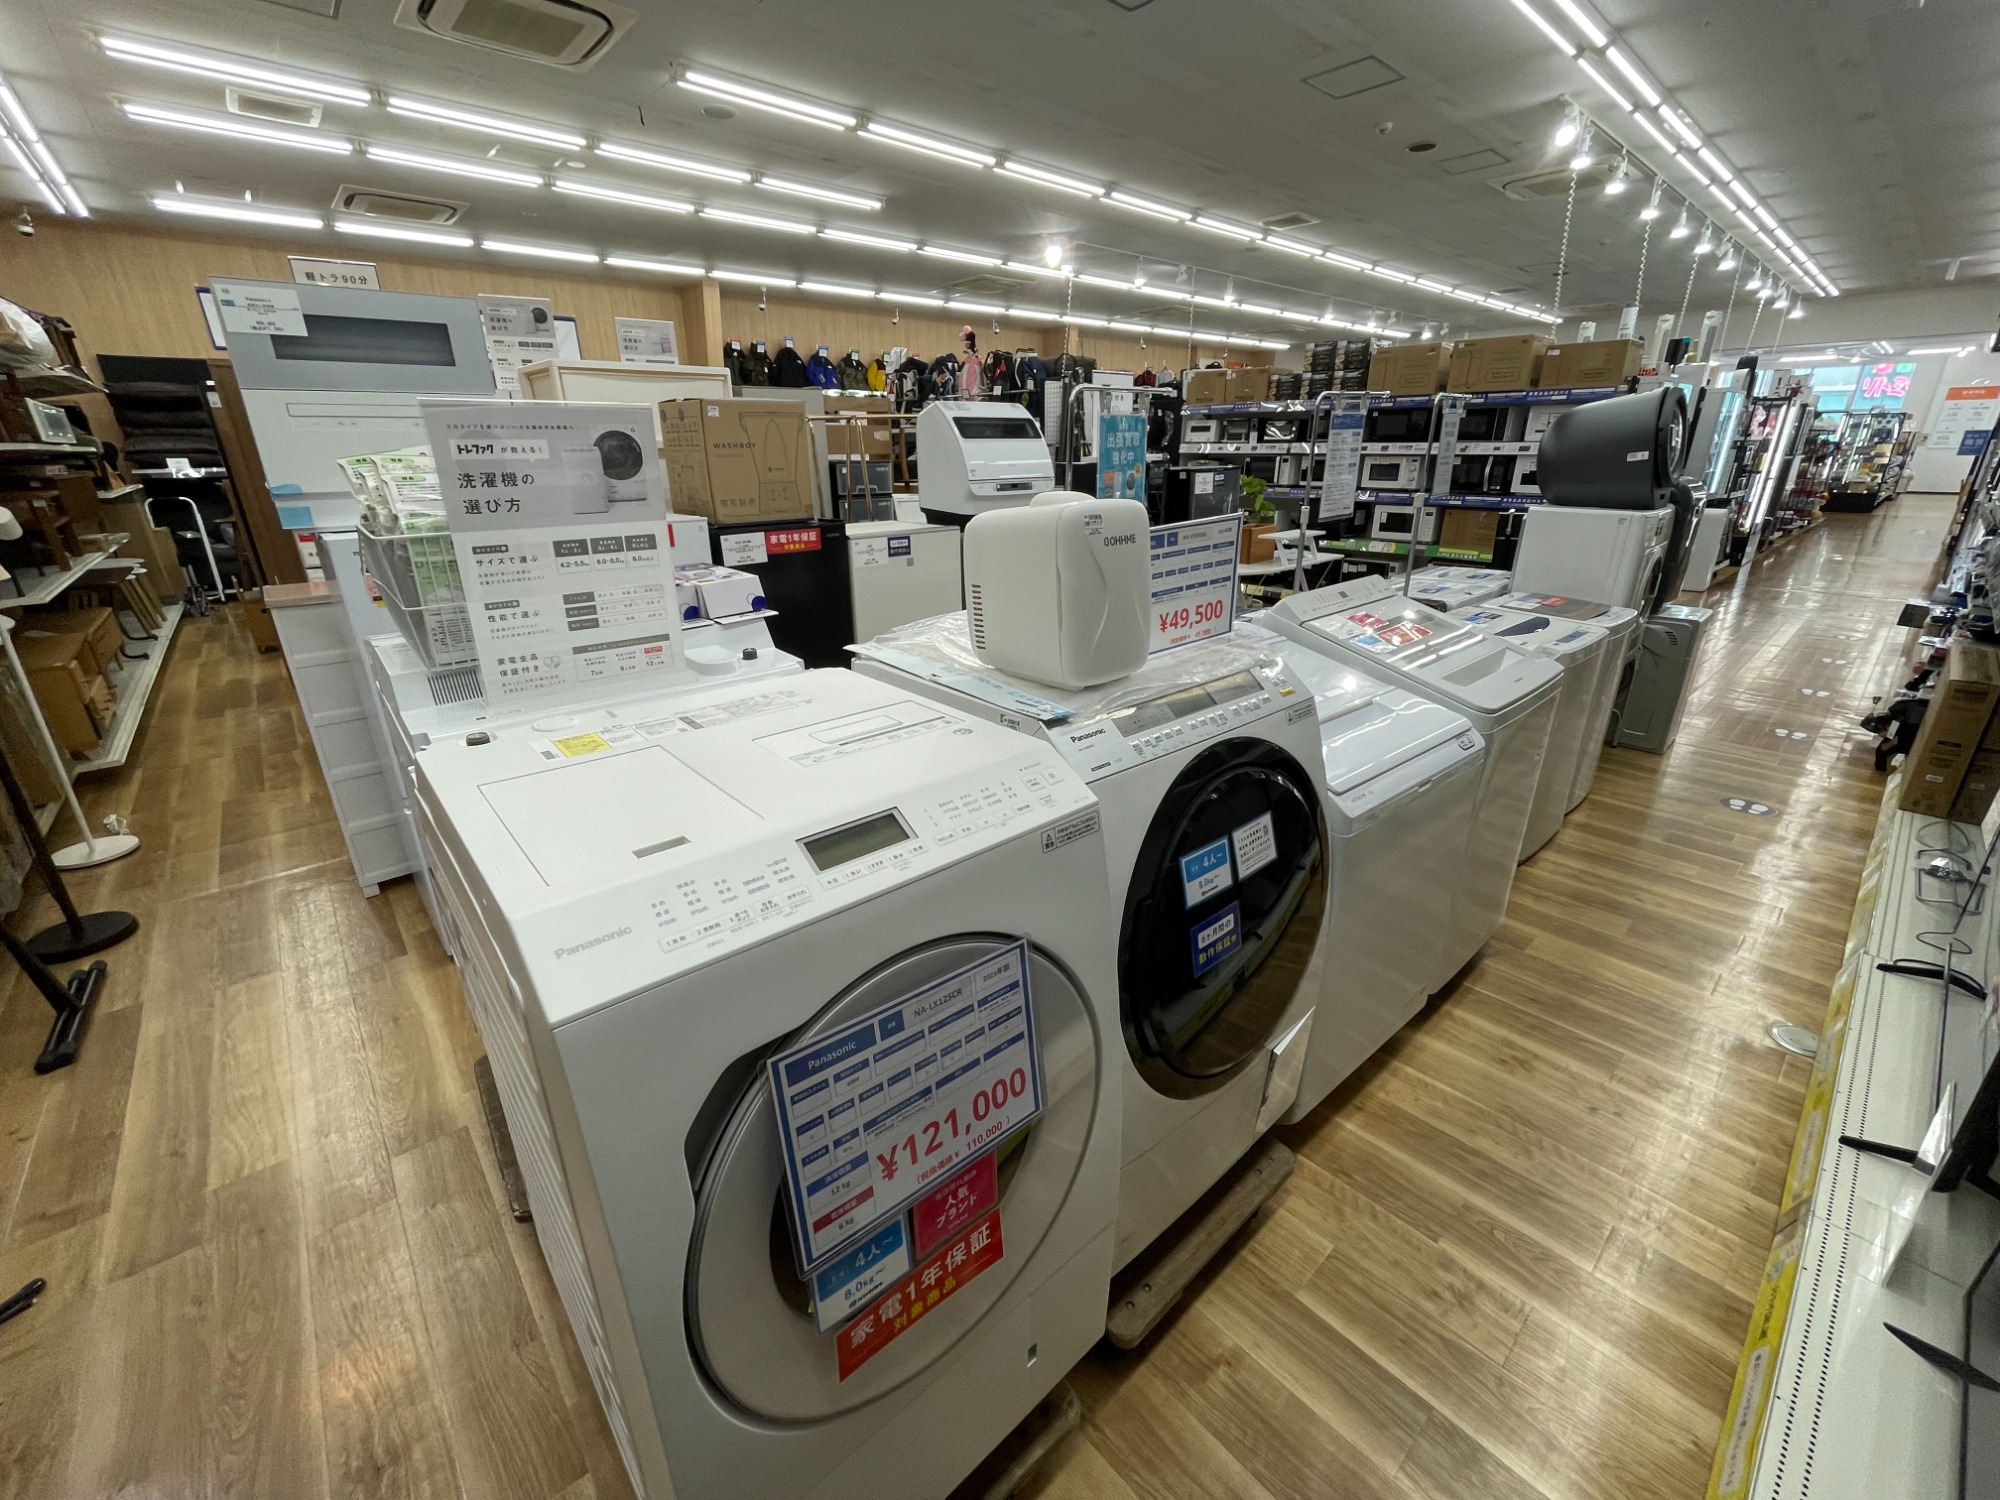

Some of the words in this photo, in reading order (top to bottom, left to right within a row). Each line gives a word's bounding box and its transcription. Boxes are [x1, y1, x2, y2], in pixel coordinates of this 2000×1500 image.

[305, 271, 368, 285] 軽トラ90分
[1106, 431, 1140, 448] 出張買取
[456, 443, 494, 455] トレファク
[1112, 450, 1135, 465] 強化中
[457, 471, 535, 489] 洗濯機の
[463, 498, 521, 515] 選び方
[769, 531, 818, 544] 家電1年保証
[1103, 533, 1137, 547] GOHHME
[475, 554, 539, 567] サイズで選ぶ
[487, 609, 541, 623] 性能で選ぶ
[1159, 599, 1223, 633] ¥49,500
[496, 653, 539, 666] 家電全品
[499, 665, 540, 678] 保証付き
[1069, 727, 1106, 744] Panasonic
[553, 924, 633, 960] Panasonic
[982, 962, 1010, 982] 2023年製
[913, 988, 963, 1018] NA-LX125CR
[808, 1041, 857, 1070] Panasonic
[876, 1067, 1026, 1181] ¥121,000
[966, 1121, 1003, 1152] 110,000
[830, 1186, 842, 1197] 12
[841, 1179, 851, 1192] kg
[944, 1185, 970, 1210] 人気
[936, 1193, 979, 1229] ブランド
[838, 1221, 845, 1230] 6
[844, 1216, 855, 1227] kg
[851, 1222, 992, 1349] 家電1年保証
[893, 1277, 957, 1333] 対象商品
